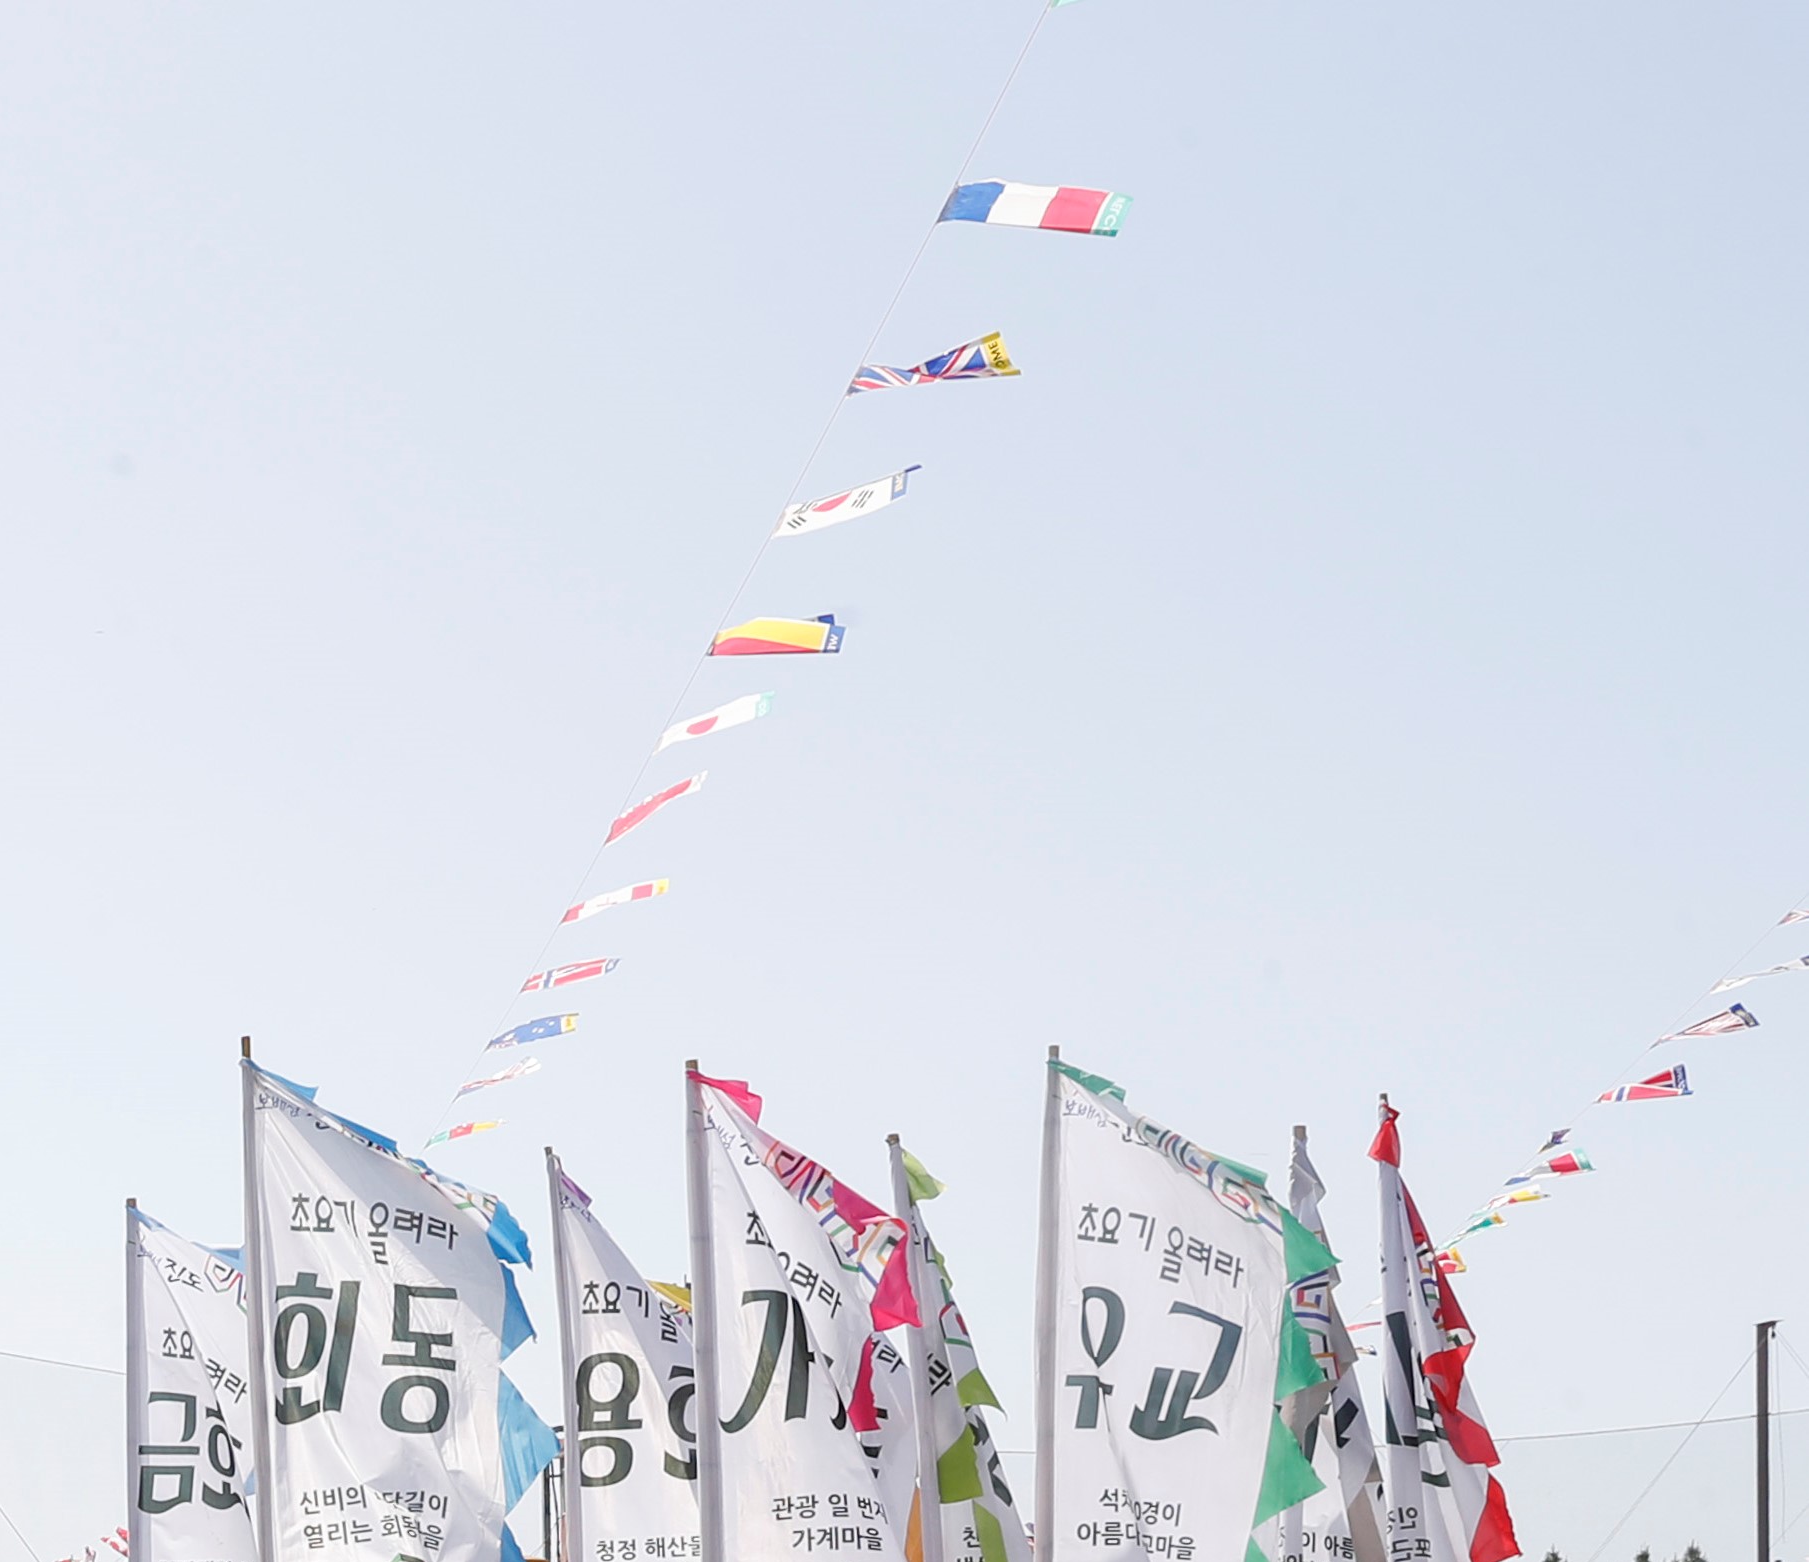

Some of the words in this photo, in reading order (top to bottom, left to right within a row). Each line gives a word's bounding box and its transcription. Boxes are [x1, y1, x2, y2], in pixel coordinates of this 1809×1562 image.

[290, 1193, 359, 1239] 초요기
[367, 1202, 459, 1265] 올려라
[1077, 1203, 1156, 1252] 초요기
[1159, 1226, 1244, 1288] 올려라
[165, 1258, 204, 1293] 진도
[583, 1279, 650, 1318] 초요기
[162, 1327, 195, 1360] 초요
[274, 1272, 457, 1434] 회동
[1065, 1286, 1243, 1441] 유교
[300, 1485, 367, 1515] 신비의
[771, 1495, 818, 1520] 관광
[828, 1494, 849, 1517] 일
[304, 1521, 373, 1549] 열리는
[596, 1539, 637, 1562] 청정
[792, 1527, 883, 1551] 가계마을
